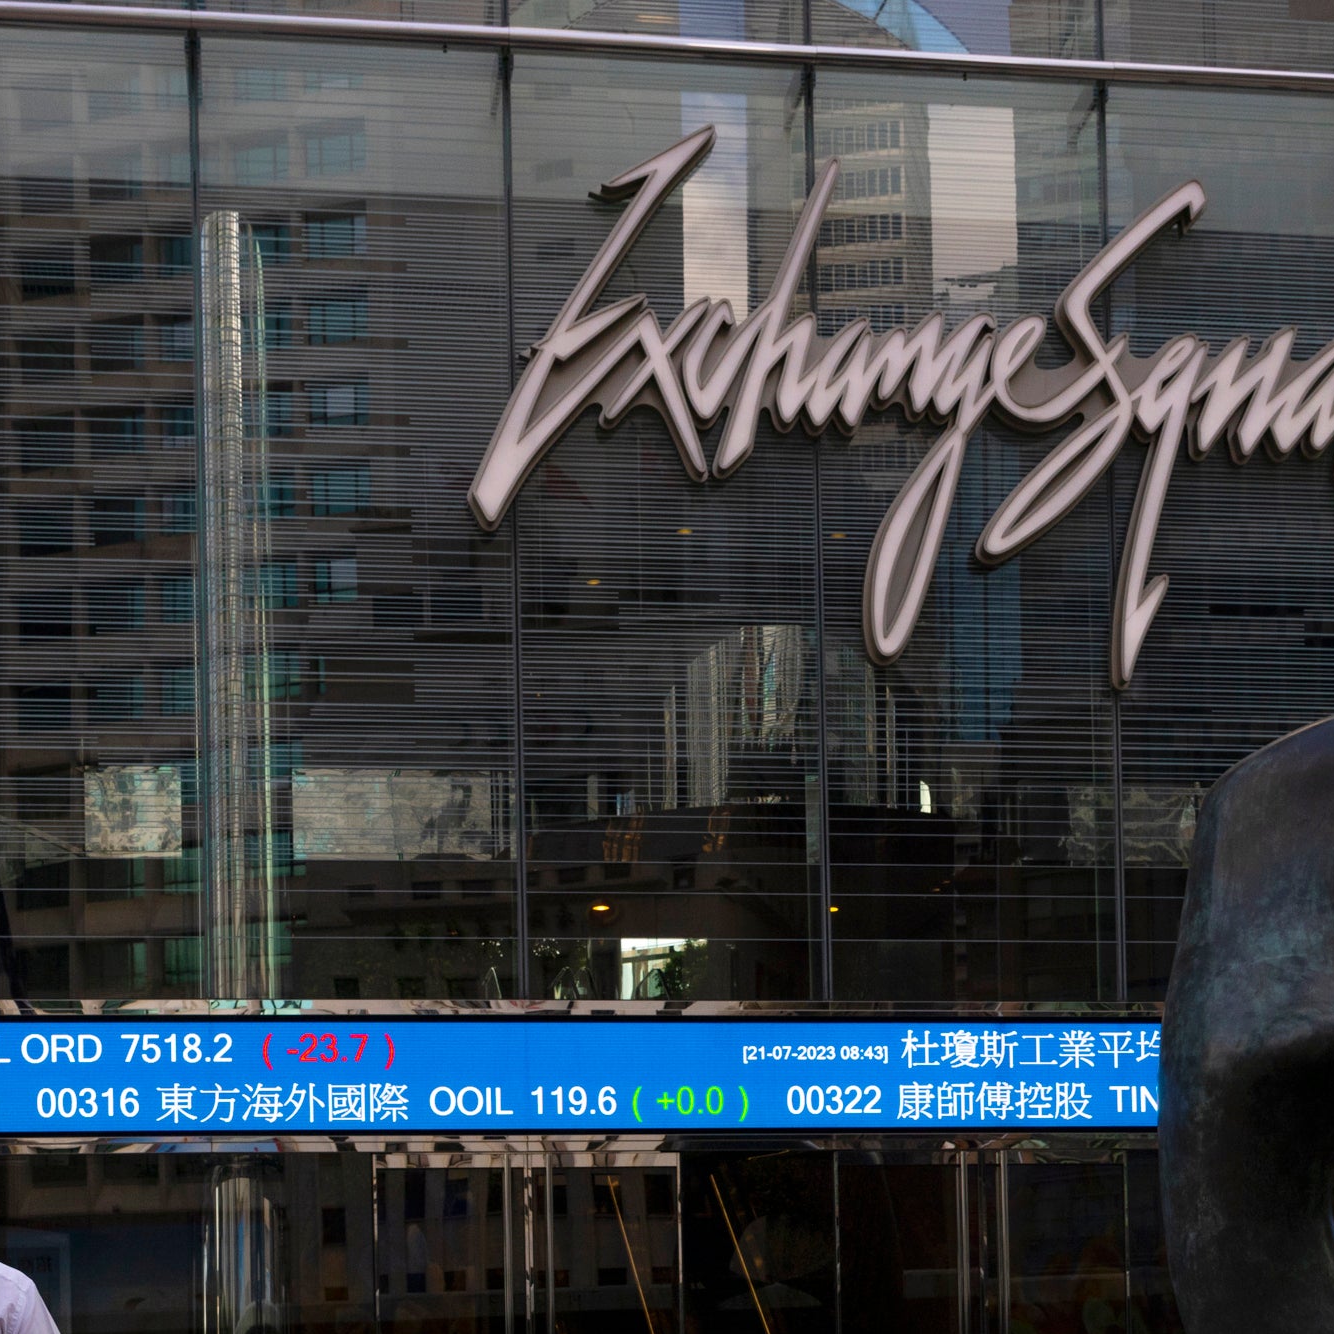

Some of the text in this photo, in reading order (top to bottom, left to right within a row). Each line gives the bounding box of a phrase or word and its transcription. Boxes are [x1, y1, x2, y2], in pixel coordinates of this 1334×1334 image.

[470, 124, 1053, 660] Exchange
[21, 1034, 102, 1063] ORD
[121, 1033, 232, 1063] 7518.2
[743, 1046, 836, 1064] [21-07-2023
[840, 1046, 888, 1064] 08:43]
[37, 1088, 139, 1118] 00316
[157, 1083, 409, 1123] 東方海外國際
[430, 1086, 513, 1116] OOIL
[531, 1086, 617, 1115] 119.6
[787, 1085, 881, 1114] 00322
[897, 1082, 1092, 1120] 康師傅控股
